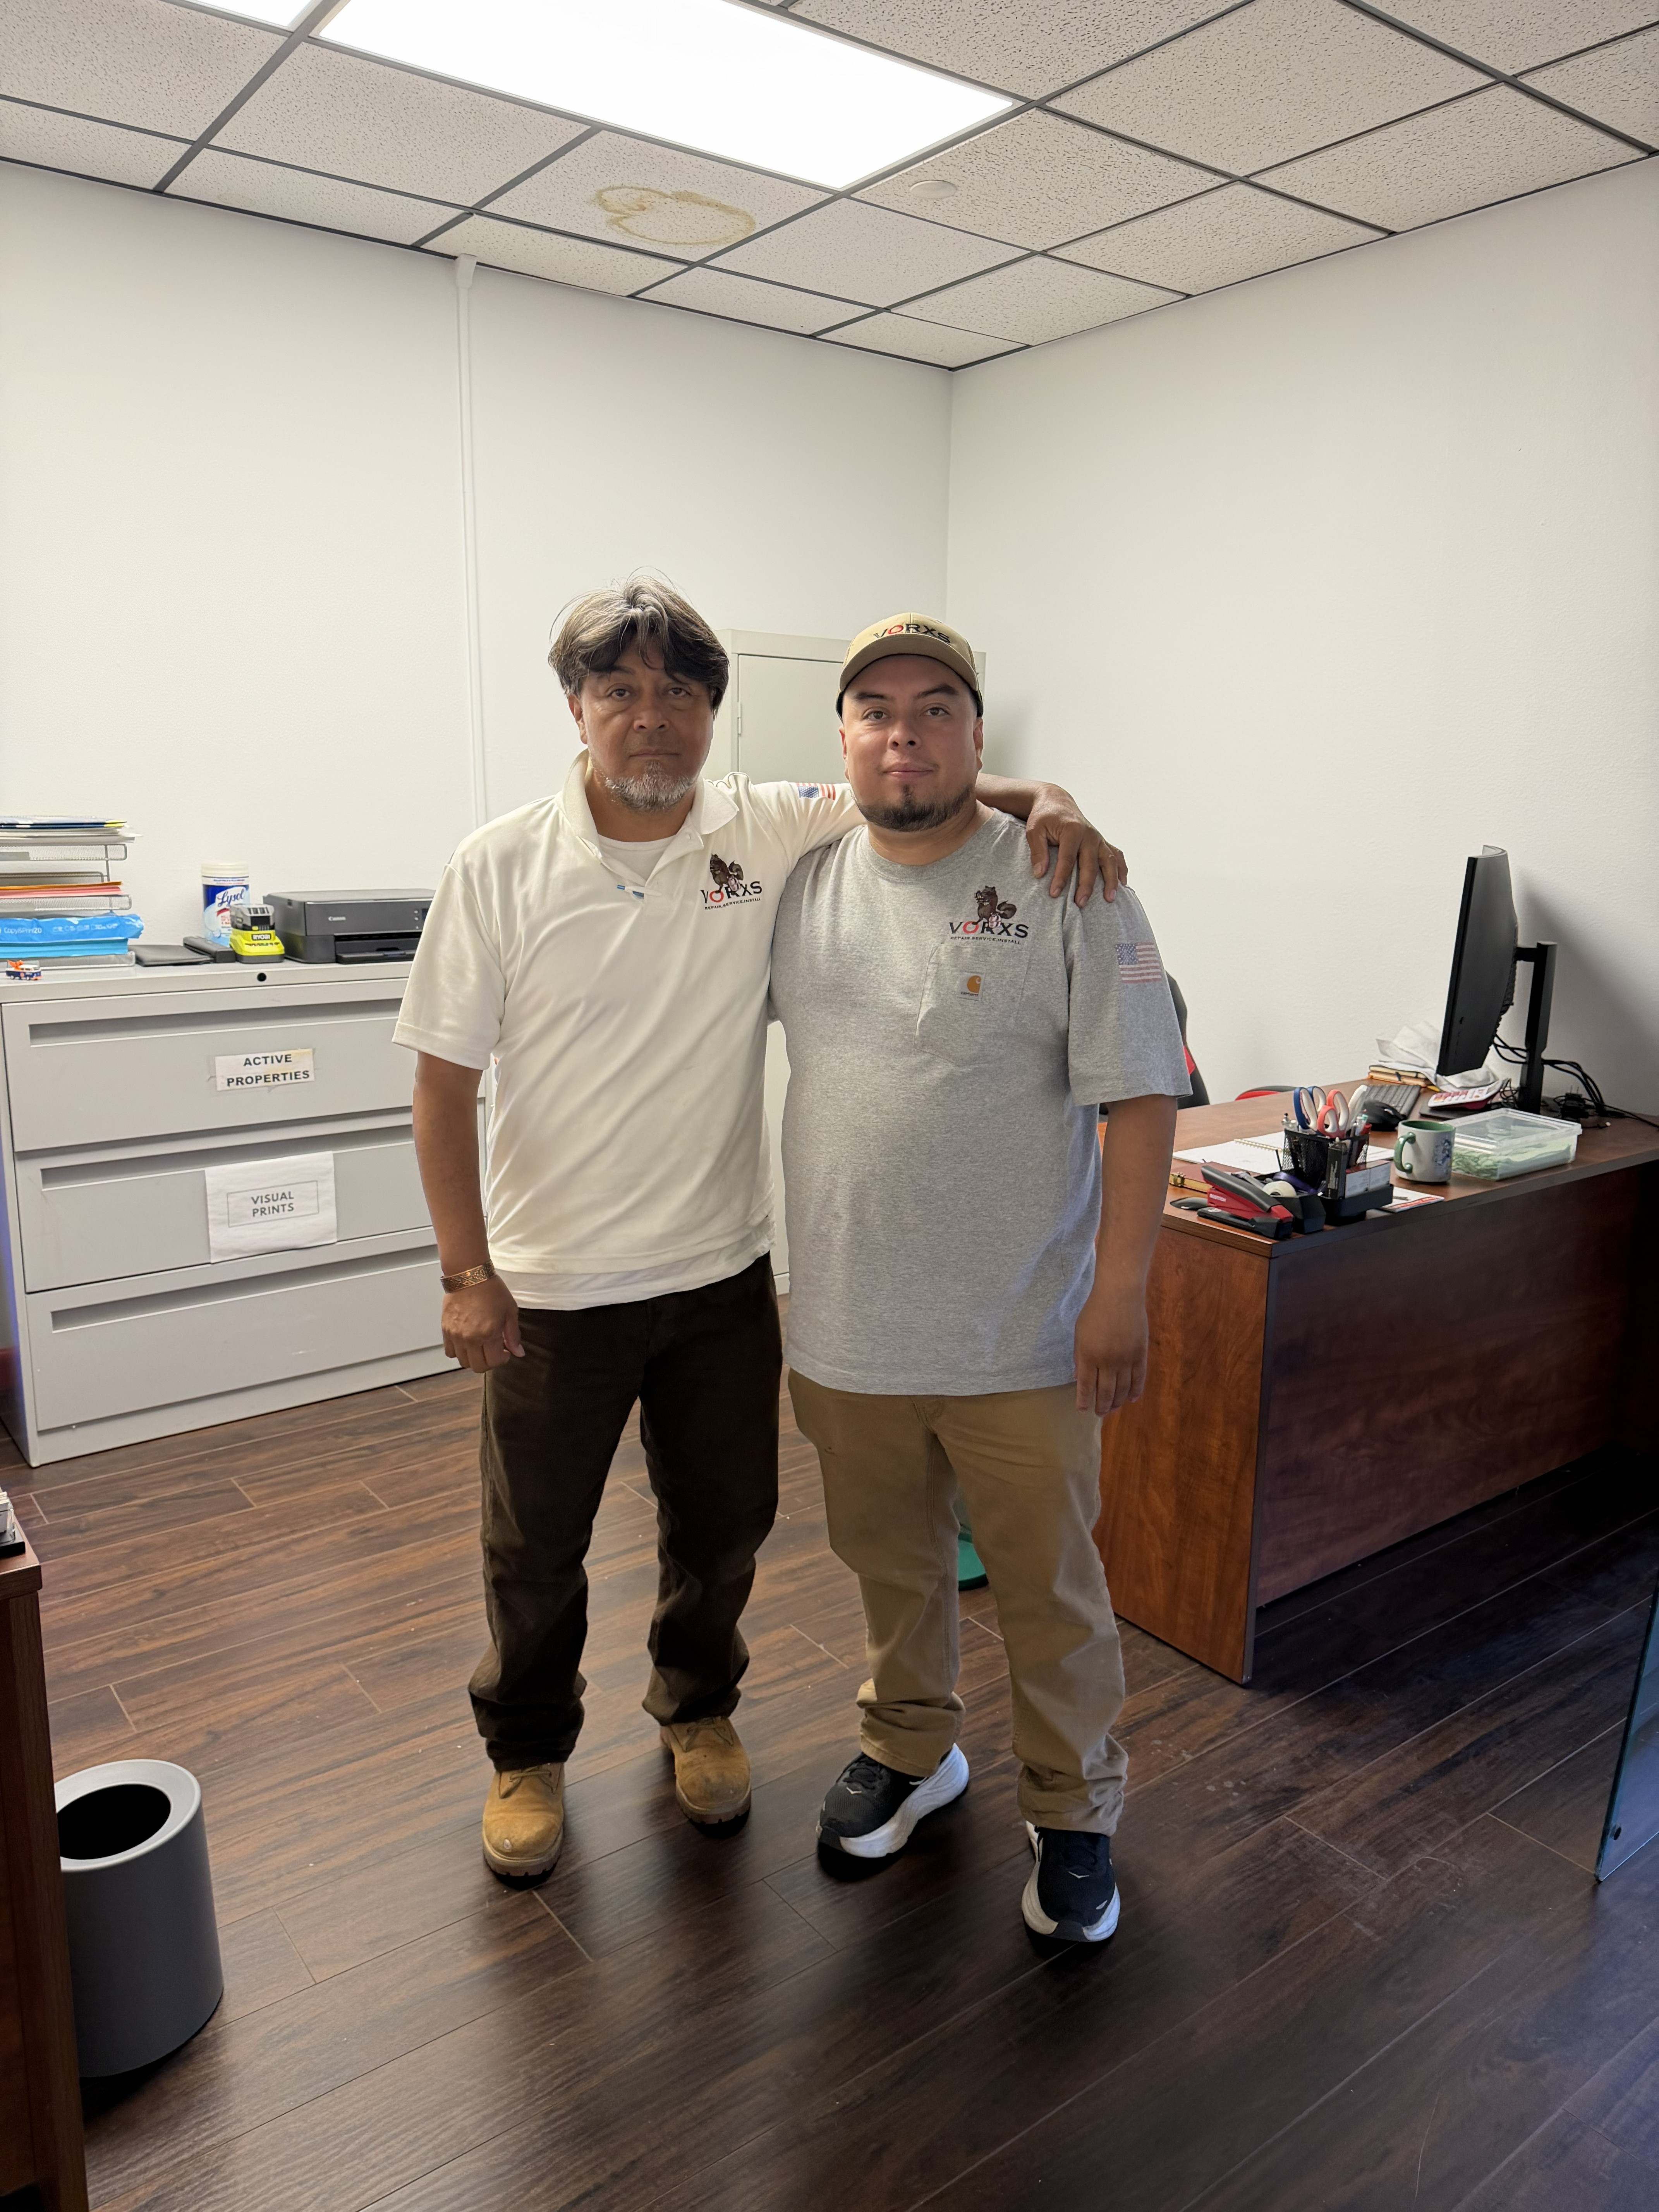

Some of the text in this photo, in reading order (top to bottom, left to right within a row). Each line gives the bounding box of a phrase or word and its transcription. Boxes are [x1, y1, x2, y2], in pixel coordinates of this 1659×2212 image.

[873, 623, 950, 644] VORXS
[217, 888, 245, 907] Lysol
[700, 881, 762, 903] VORXS
[949, 921, 1029, 938] VORXS
[243, 1054, 292, 1066] ACTIVE
[227, 1070, 310, 1087] PROPERTIES
[251, 1191, 294, 1205] VISUAL
[252, 1202, 294, 1217] PRINTS
